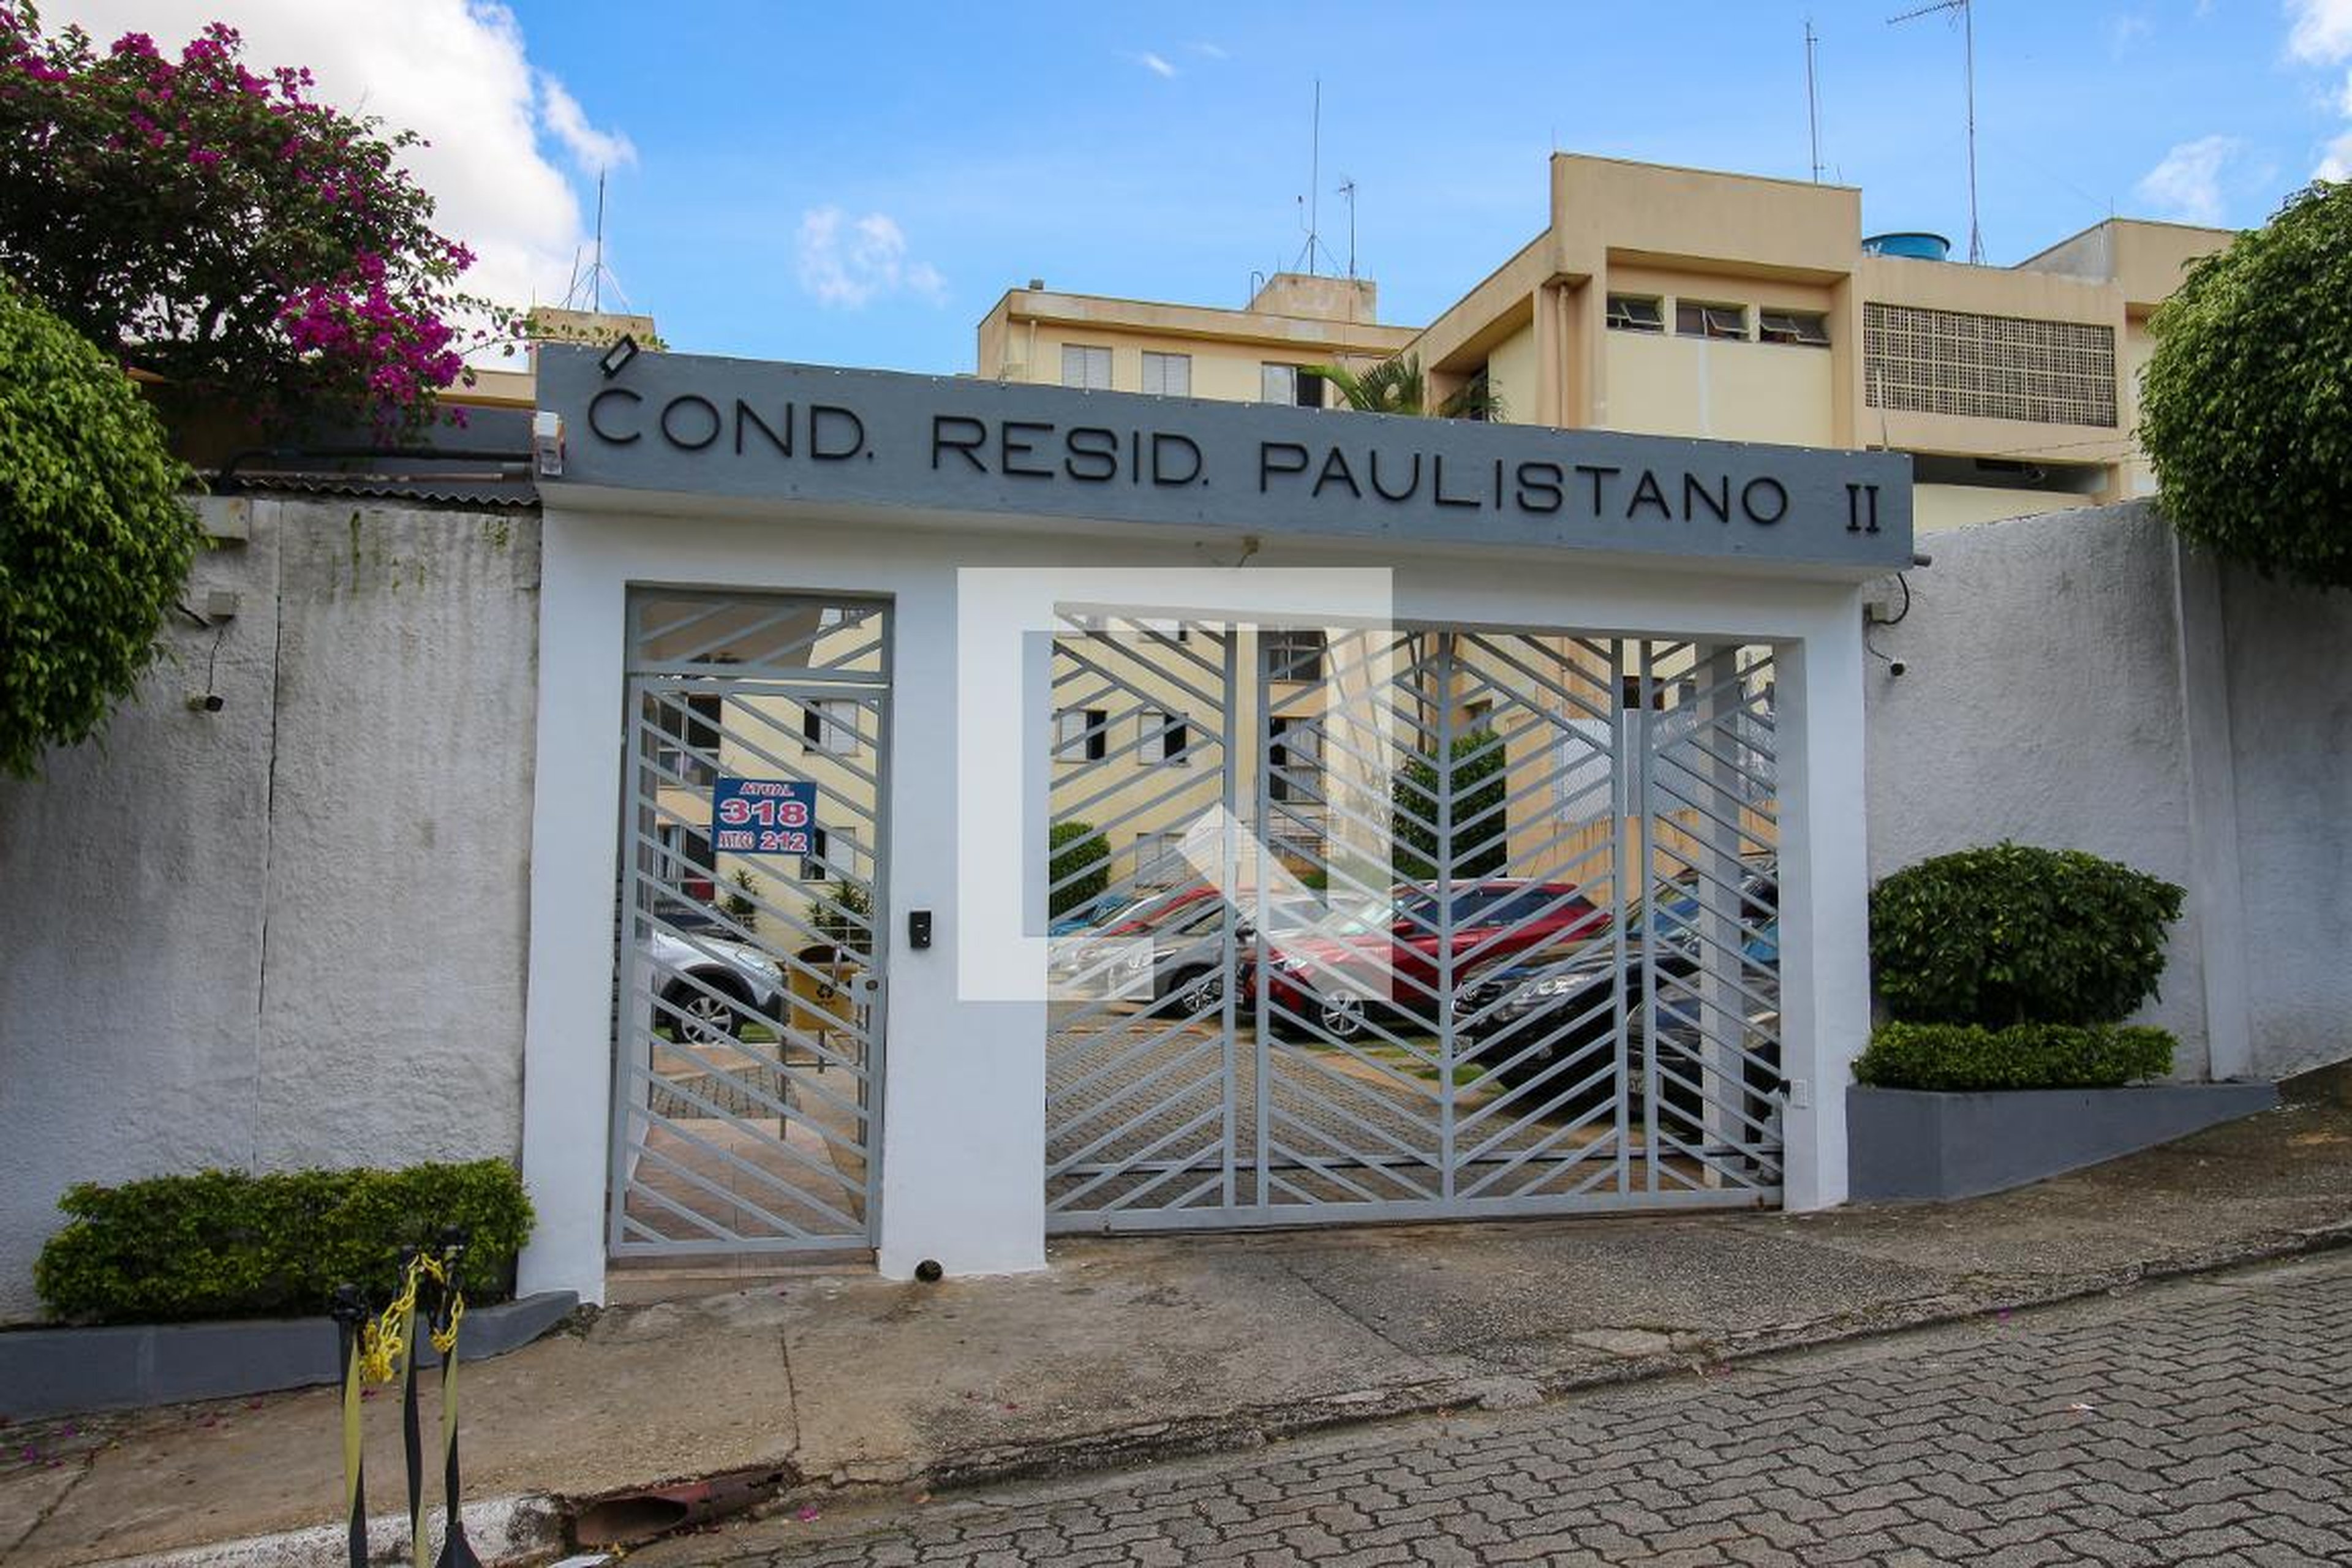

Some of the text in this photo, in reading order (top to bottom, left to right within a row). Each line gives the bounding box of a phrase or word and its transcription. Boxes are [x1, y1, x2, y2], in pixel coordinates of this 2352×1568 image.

[586, 386, 1882, 535] COND. RESID. PAULISTANO II
[720, 798, 809, 827] 318
[759, 831, 807, 851] 212
